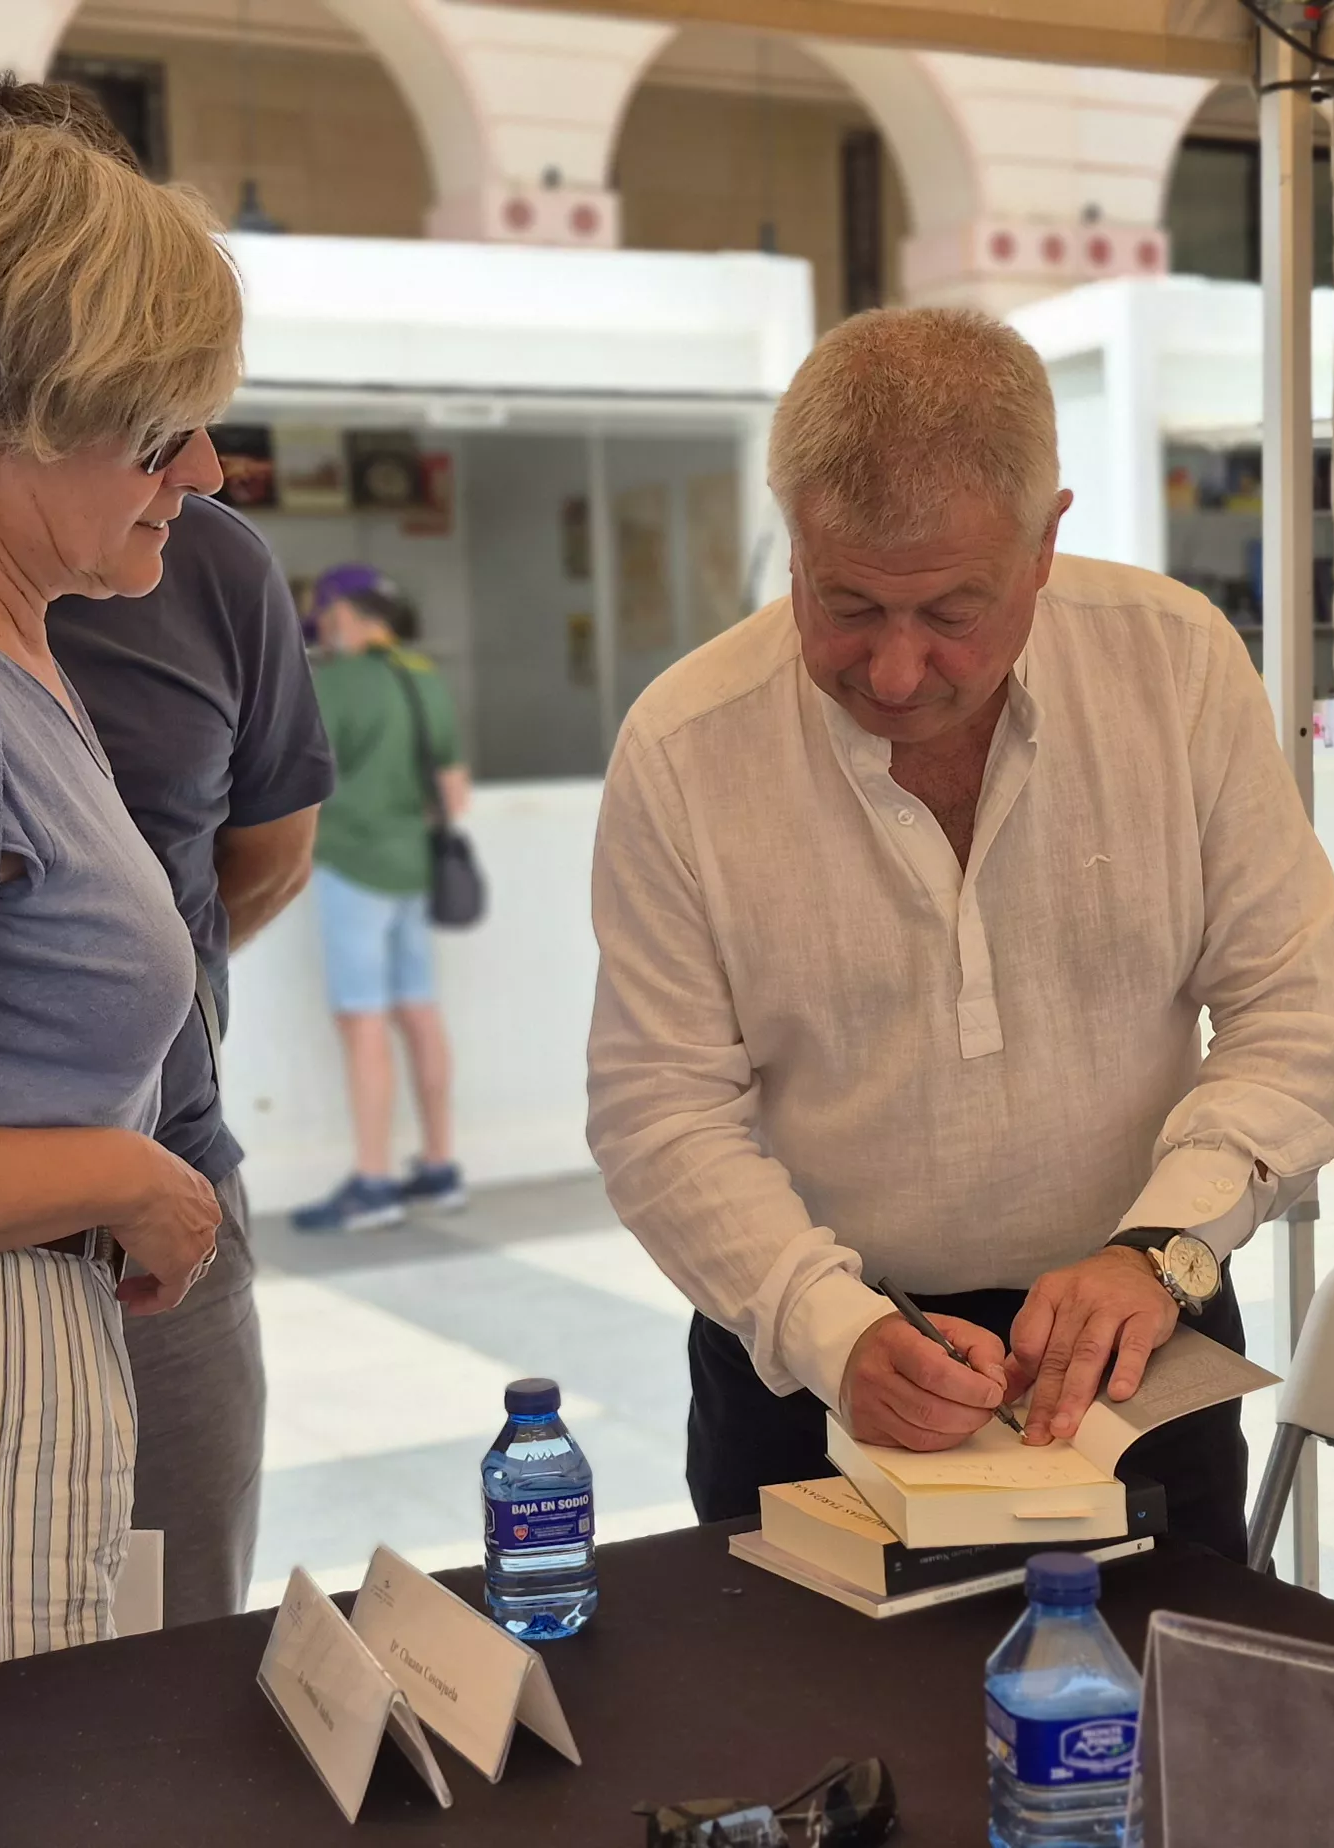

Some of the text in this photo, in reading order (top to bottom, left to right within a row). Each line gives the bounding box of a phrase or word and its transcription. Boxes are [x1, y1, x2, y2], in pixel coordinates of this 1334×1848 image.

[511, 1503, 539, 1516] BAJA
[540, 1501, 556, 1512] EN
[557, 1494, 589, 1510] SODIO
